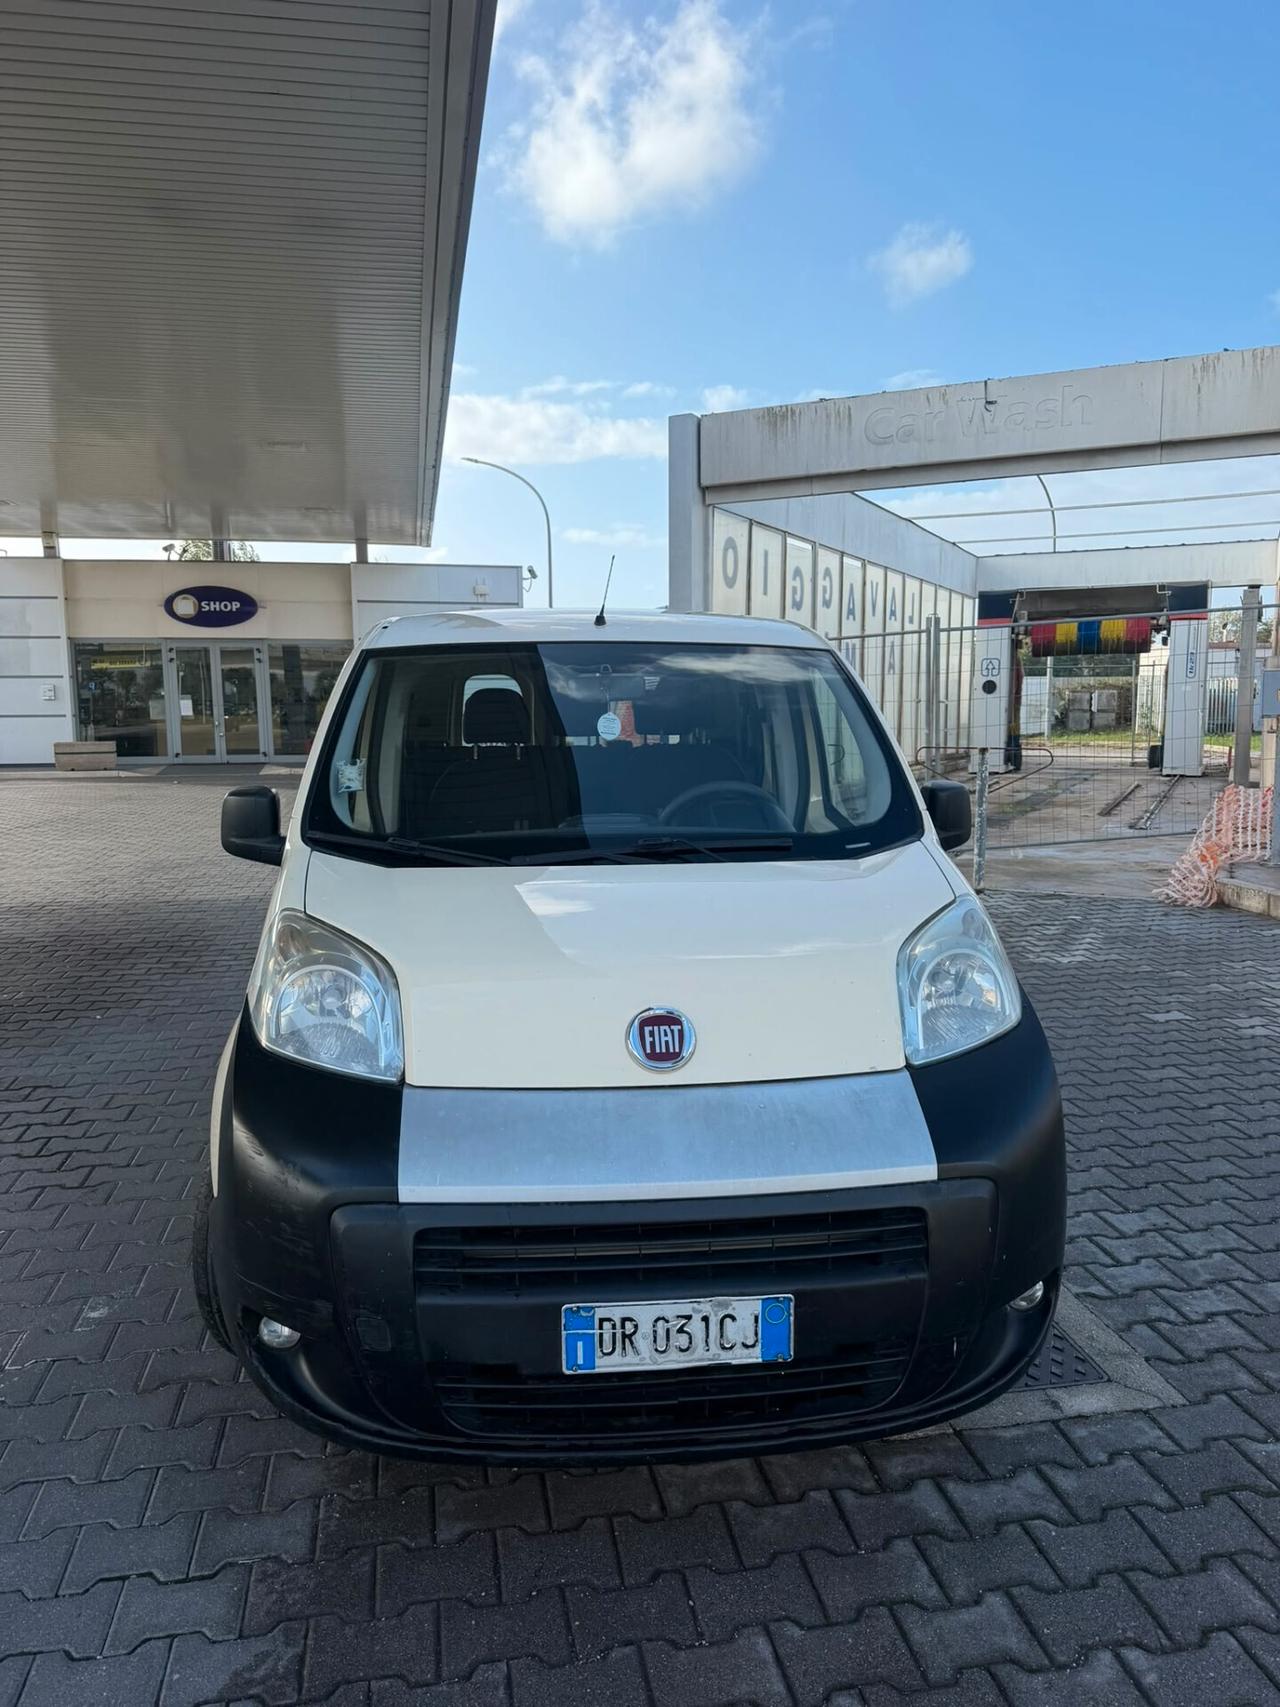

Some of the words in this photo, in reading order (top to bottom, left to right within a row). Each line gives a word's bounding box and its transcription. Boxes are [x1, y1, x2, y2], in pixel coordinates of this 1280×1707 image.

[863, 406, 945, 446] Car
[955, 384, 1095, 436] Wash
[200, 600, 241, 612] SHOP
[643, 1025, 682, 1054] FIAT
[597, 1316, 640, 1358] DR
[651, 1311, 760, 1354] 031CJ
